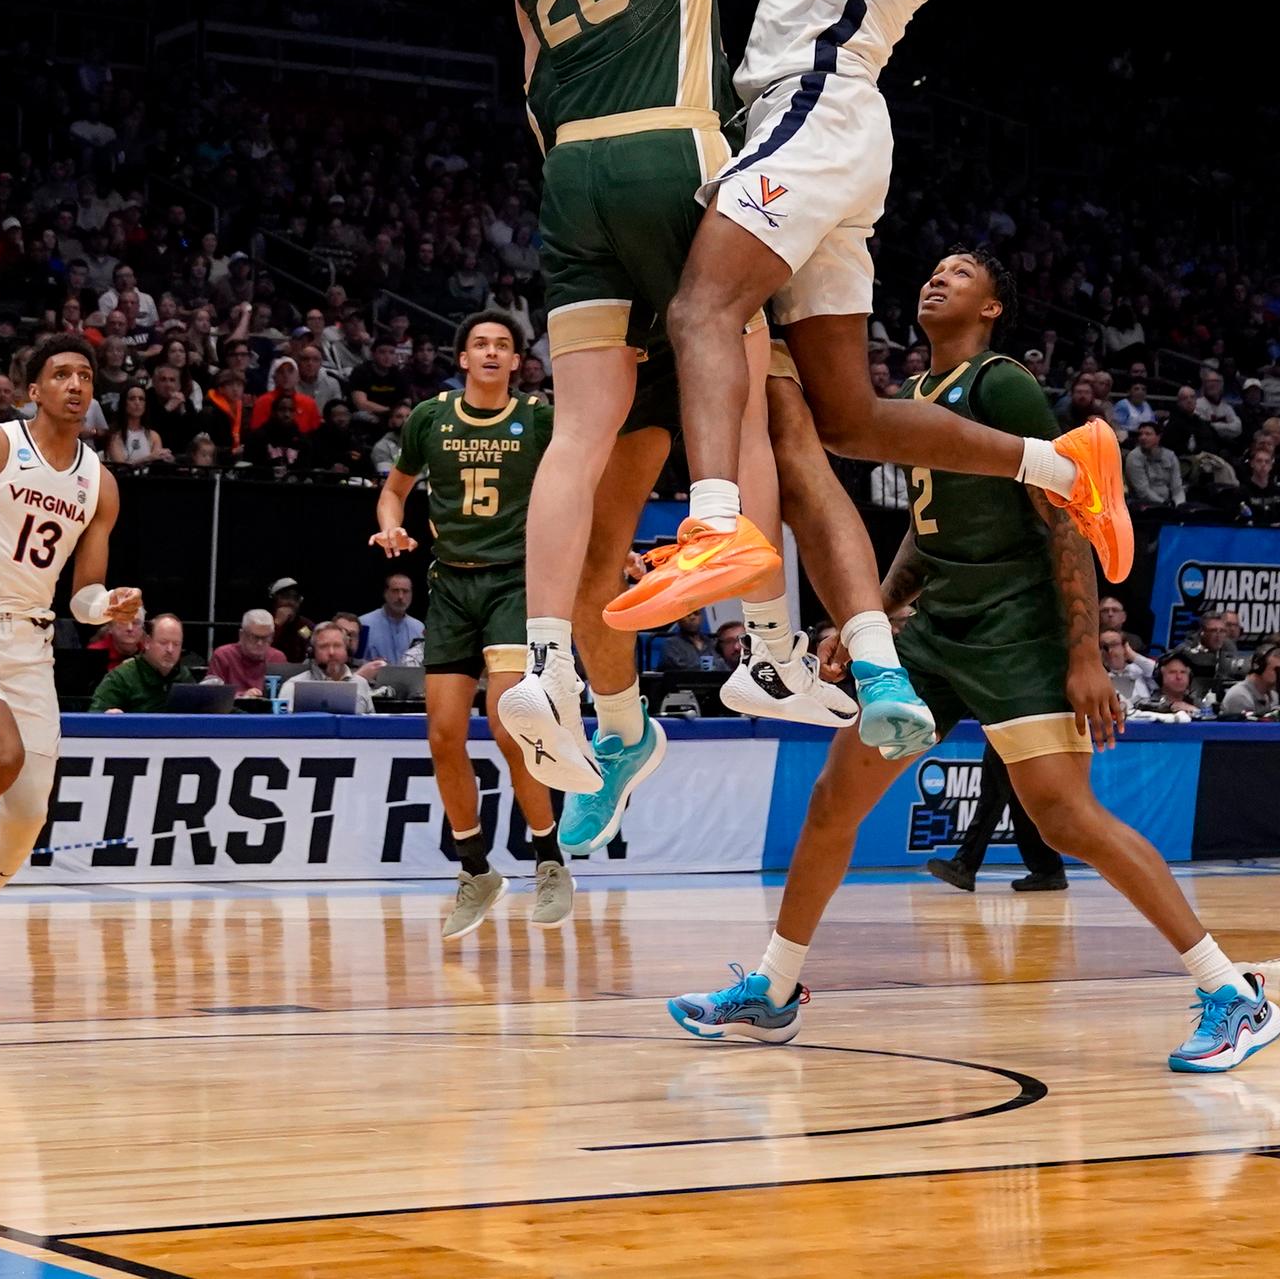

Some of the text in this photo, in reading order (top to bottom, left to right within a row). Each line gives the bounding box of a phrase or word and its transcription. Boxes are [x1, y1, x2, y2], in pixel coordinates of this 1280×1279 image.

[442, 438, 521, 452] COLORADO
[458, 450, 503, 463] STATE
[9, 483, 87, 526] VIRGINIA
[459, 467, 500, 517] 15
[911, 467, 939, 536] 2
[13, 513, 64, 570] 13
[31, 756, 354, 867] FIRST
